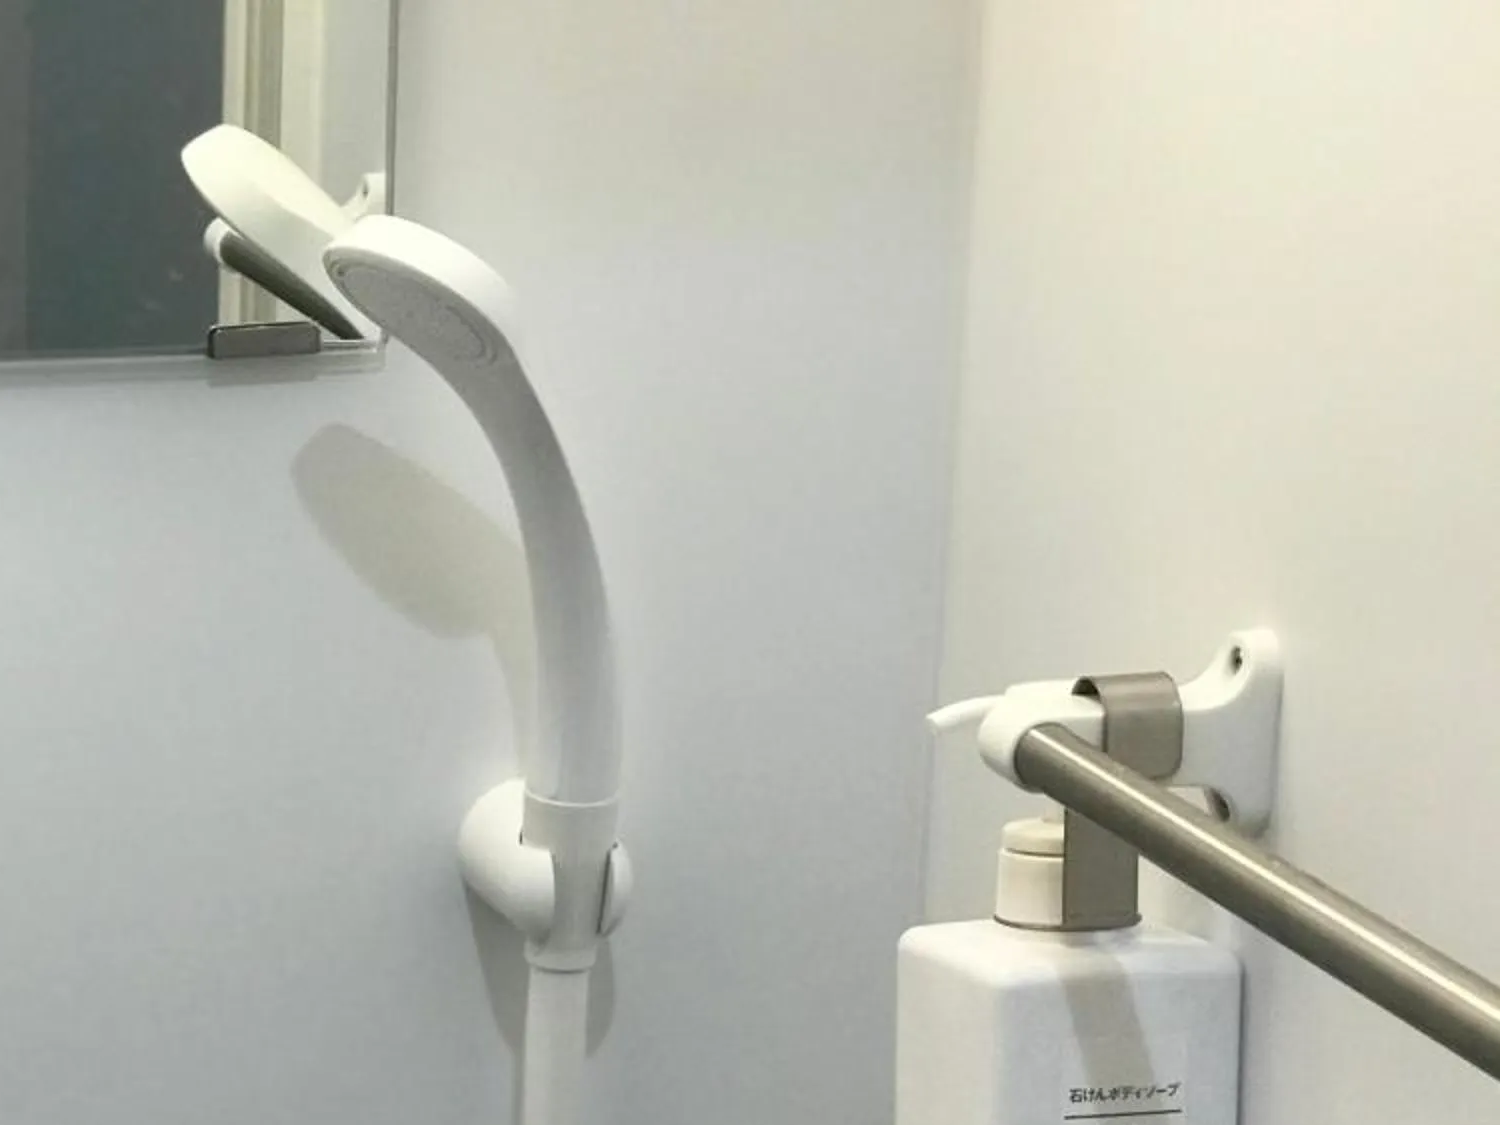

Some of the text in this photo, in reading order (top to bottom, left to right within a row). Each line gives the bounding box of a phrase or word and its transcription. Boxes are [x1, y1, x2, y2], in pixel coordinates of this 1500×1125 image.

[1069, 1081, 1182, 1103] 石けんボディソープ
